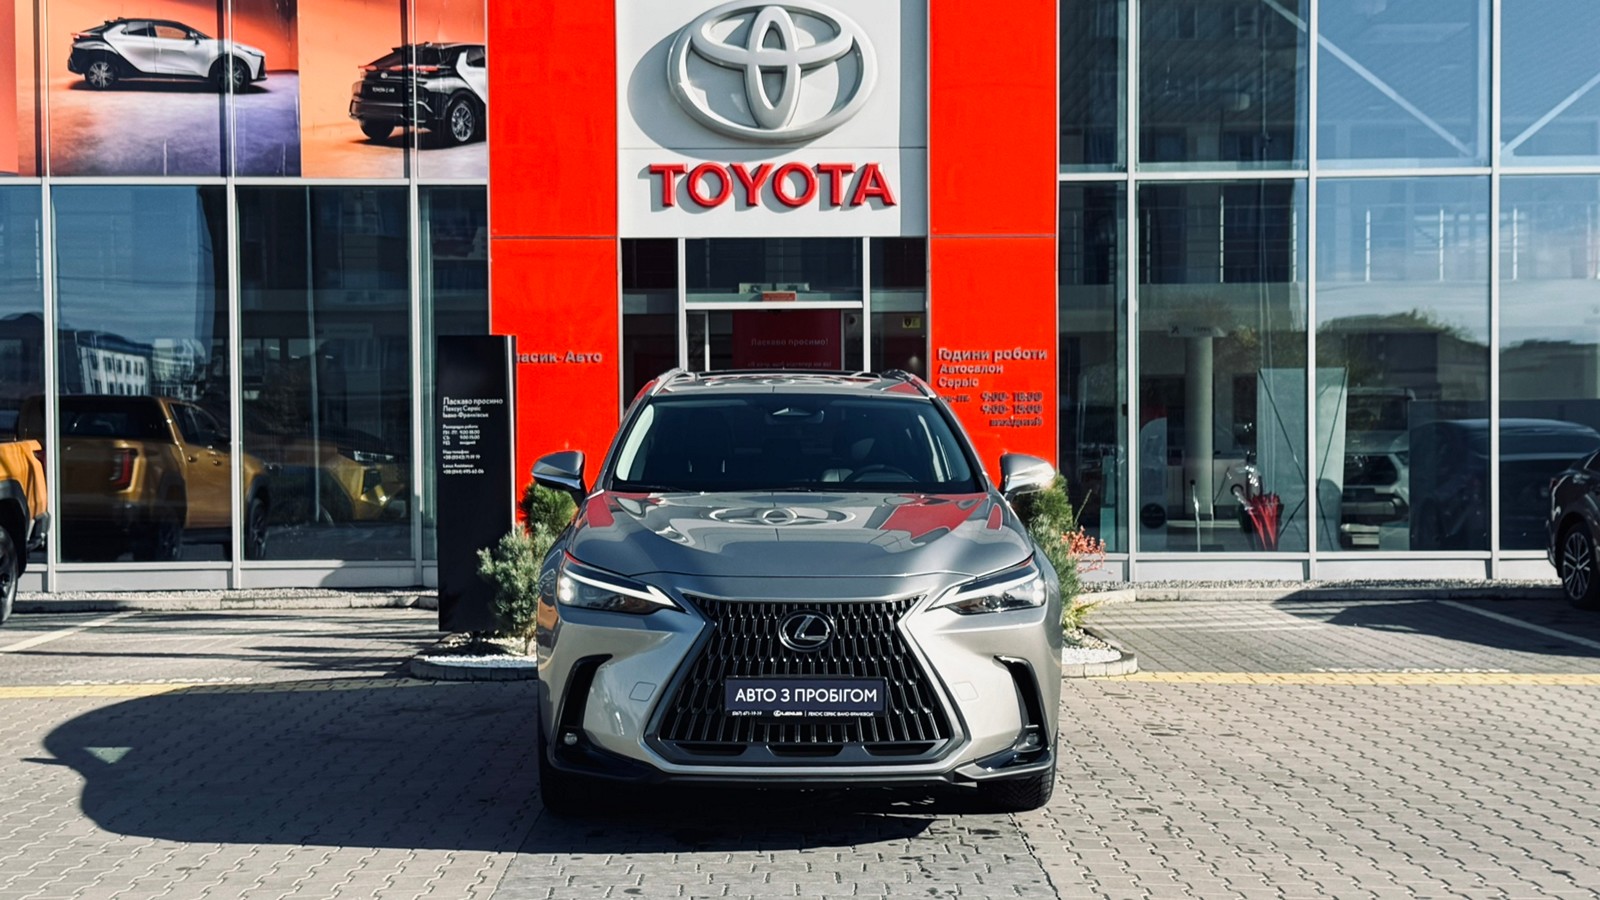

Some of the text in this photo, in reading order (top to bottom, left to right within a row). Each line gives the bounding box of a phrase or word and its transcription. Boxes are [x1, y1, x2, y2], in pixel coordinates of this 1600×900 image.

[649, 161, 897, 208] TOYOTA
[937, 346, 1048, 363] Години роботи
[939, 364, 1004, 374] Автосалон
[938, 378, 980, 389] Сервіс
[443, 397, 504, 406] Ласкаво просимо
[735, 688, 777, 702] АВТО
[795, 688, 877, 702] ПРОБІГОМ
